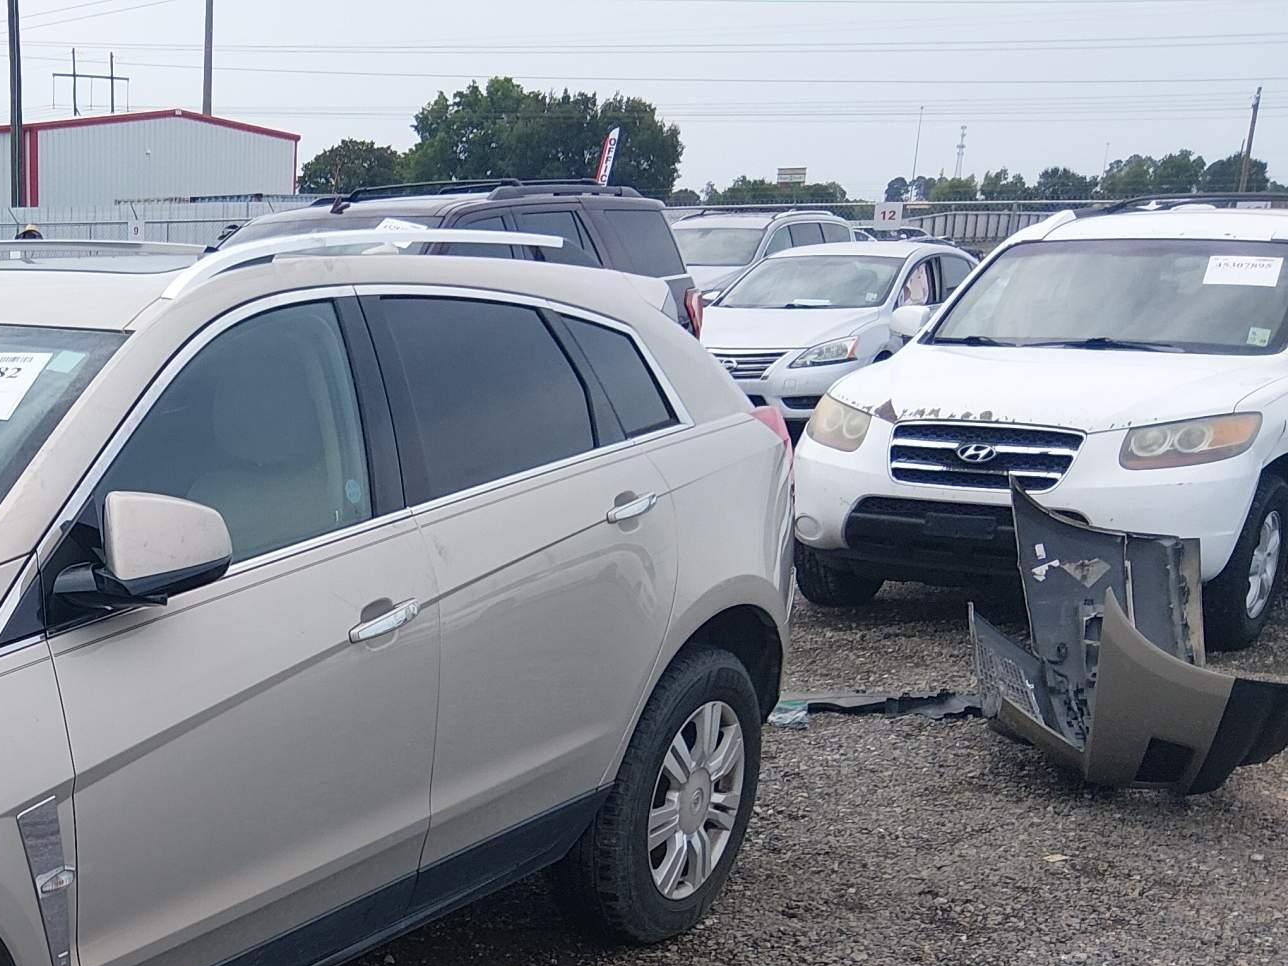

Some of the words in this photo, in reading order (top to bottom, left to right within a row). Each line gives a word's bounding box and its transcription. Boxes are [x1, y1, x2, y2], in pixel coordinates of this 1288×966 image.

[599, 138, 616, 185] OFFIC
[880, 210, 897, 221] 12
[133, 226, 139, 236] 9
